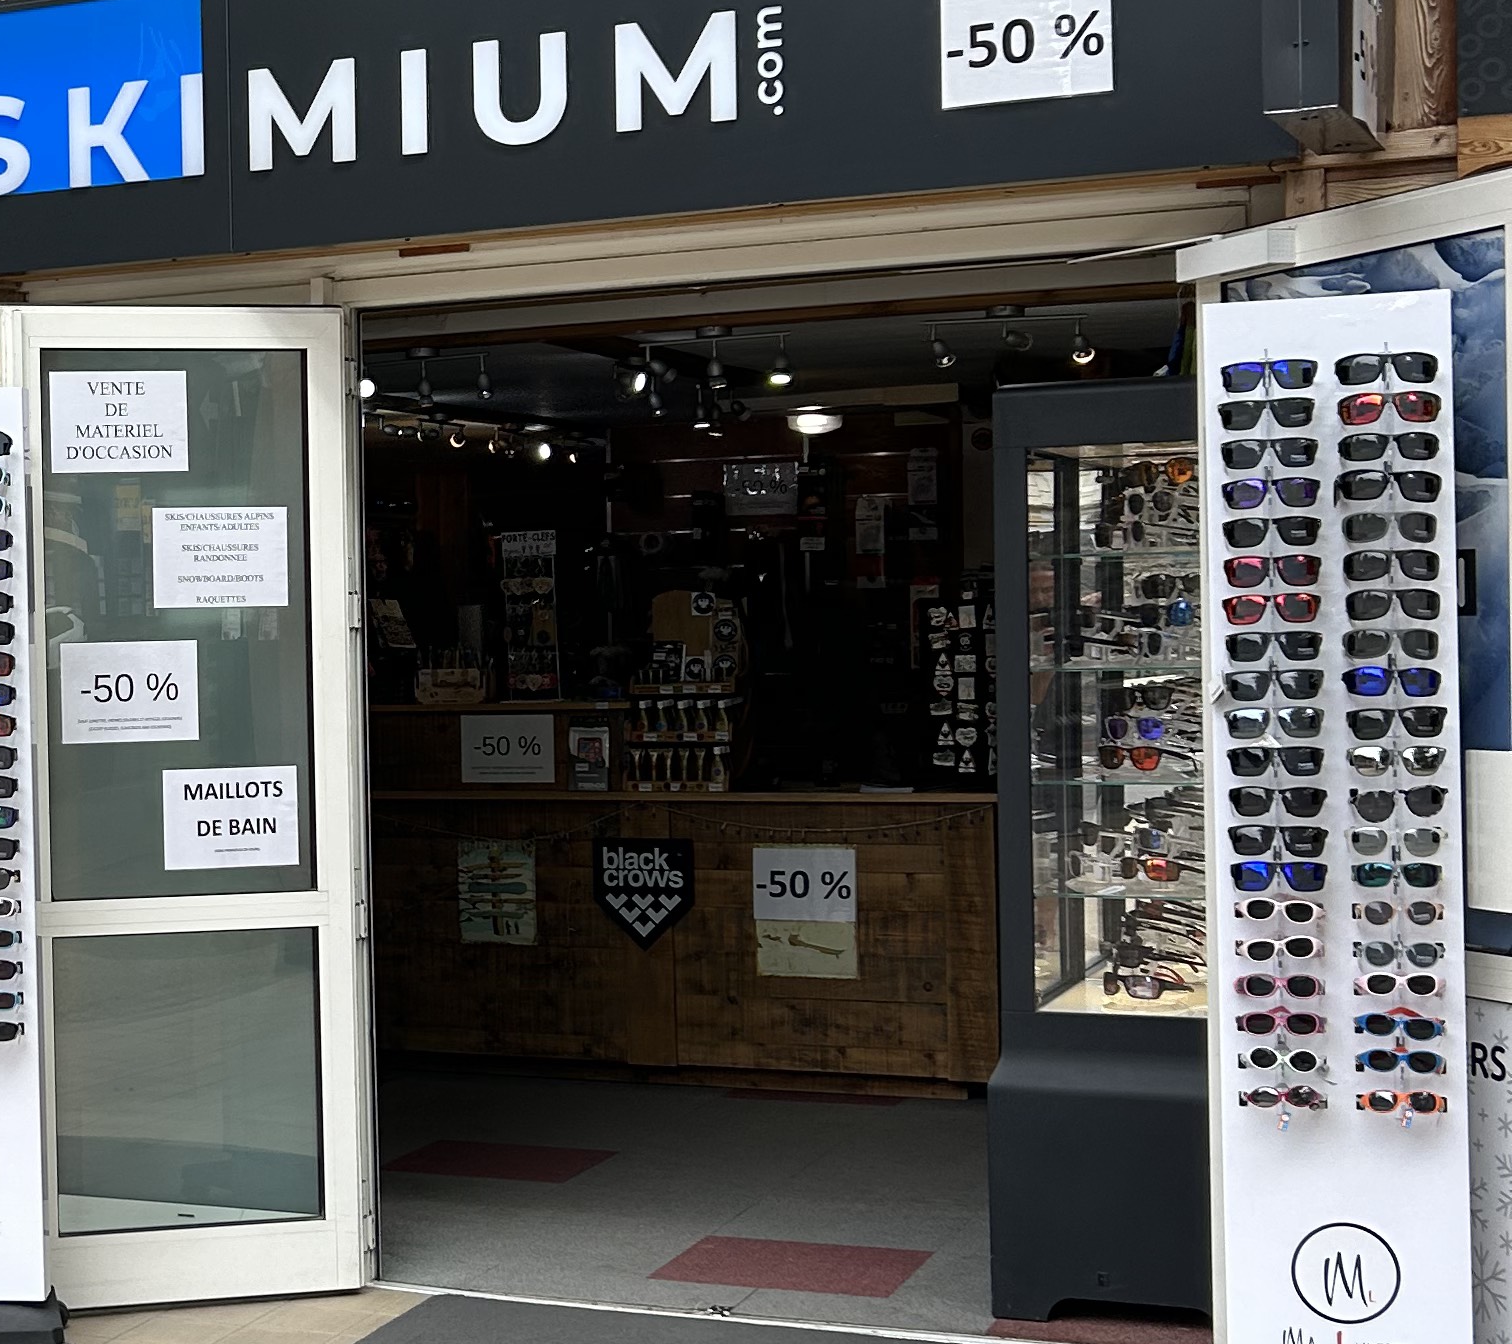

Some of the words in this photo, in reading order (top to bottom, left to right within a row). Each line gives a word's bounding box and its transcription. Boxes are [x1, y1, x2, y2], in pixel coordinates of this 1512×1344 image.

[947, 18, 1035, 68] -50
[1053, 10, 1104, 61] %
[756, 5, 785, 116] .com
[88, 382, 145, 395] VENTE
[105, 403, 128, 416] DE
[75, 424, 163, 438] MATERIEL
[67, 445, 172, 459] D'OCCASION
[196, 596, 246, 604] RAQUETTES
[81, 674, 134, 703] -50
[147, 673, 179, 701] %
[474, 736, 510, 756] -50
[518, 736, 541, 755] %
[184, 781, 283, 800] MAILLOTS
[197, 820, 222, 836] DE
[229, 817, 276, 835] BAIN
[603, 847, 669, 869] black
[603, 868, 684, 888] crows
[756, 870, 810, 898] -50
[821, 870, 851, 899] %
